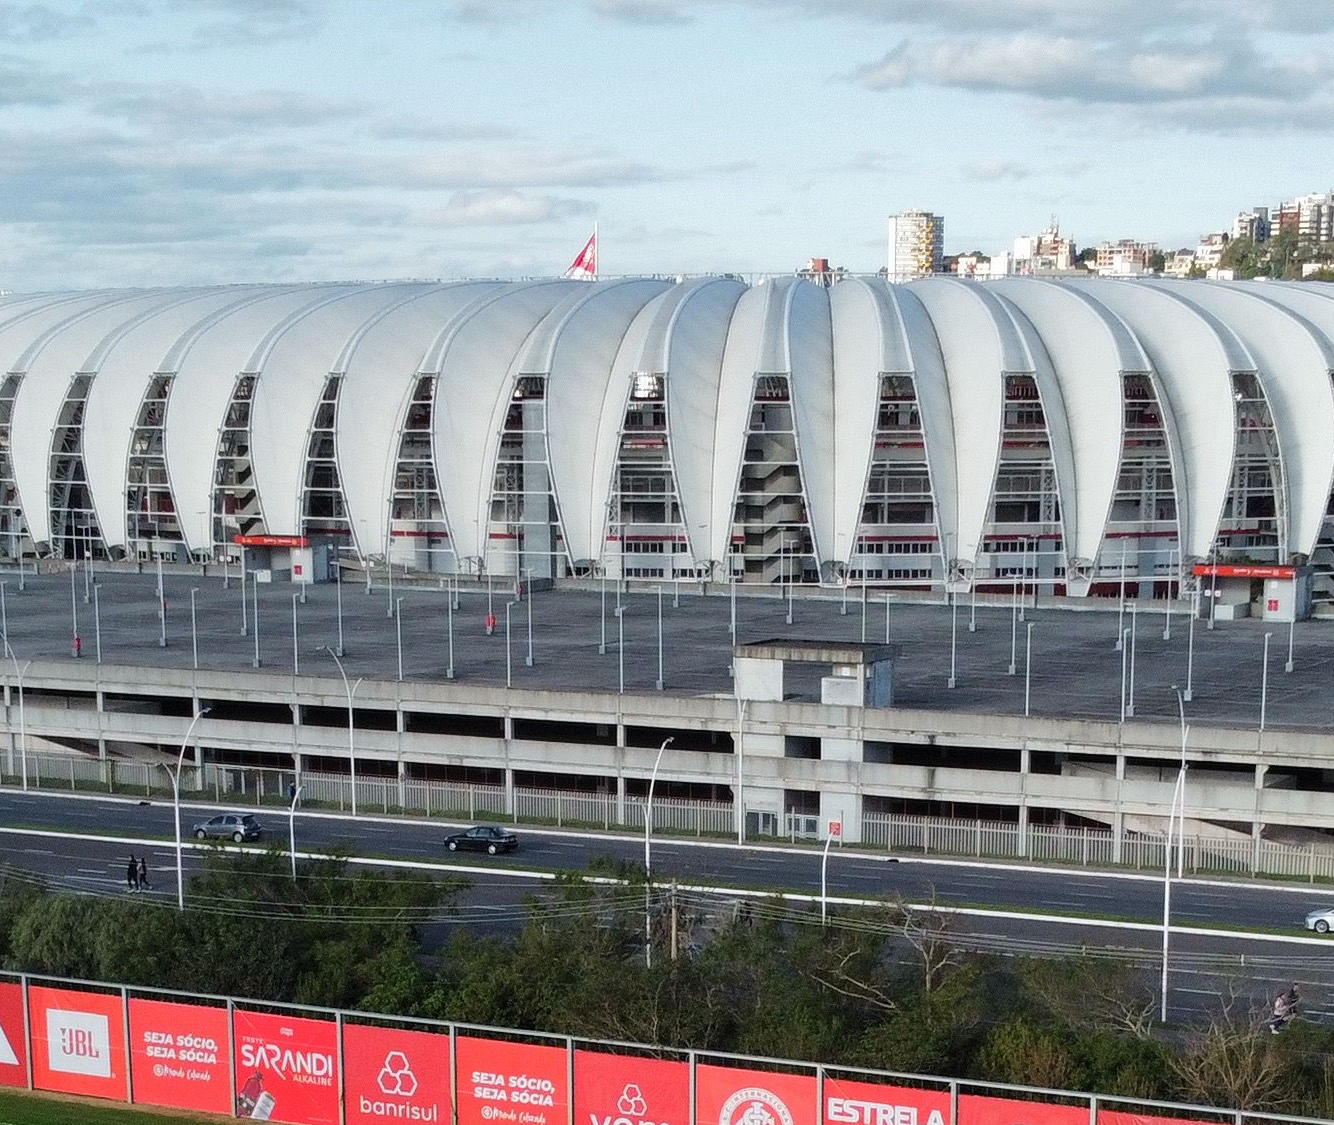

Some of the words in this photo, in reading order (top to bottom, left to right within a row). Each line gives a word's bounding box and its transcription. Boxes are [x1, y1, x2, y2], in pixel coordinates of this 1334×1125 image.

[60, 1027, 99, 1058] JBL
[143, 1032, 174, 1045] SEJA
[176, 1034, 218, 1052] SÓCIO,
[146, 1046, 176, 1059] SEJA
[178, 1048, 217, 1064] SÓCIA
[241, 1043, 333, 1080] SARANDI
[471, 1071, 505, 1086] SEJA
[508, 1074, 555, 1094] SÓCIO,
[474, 1086, 508, 1101] SEJA
[511, 1090, 554, 1107] SÓCIA
[360, 1095, 438, 1123] banrisul
